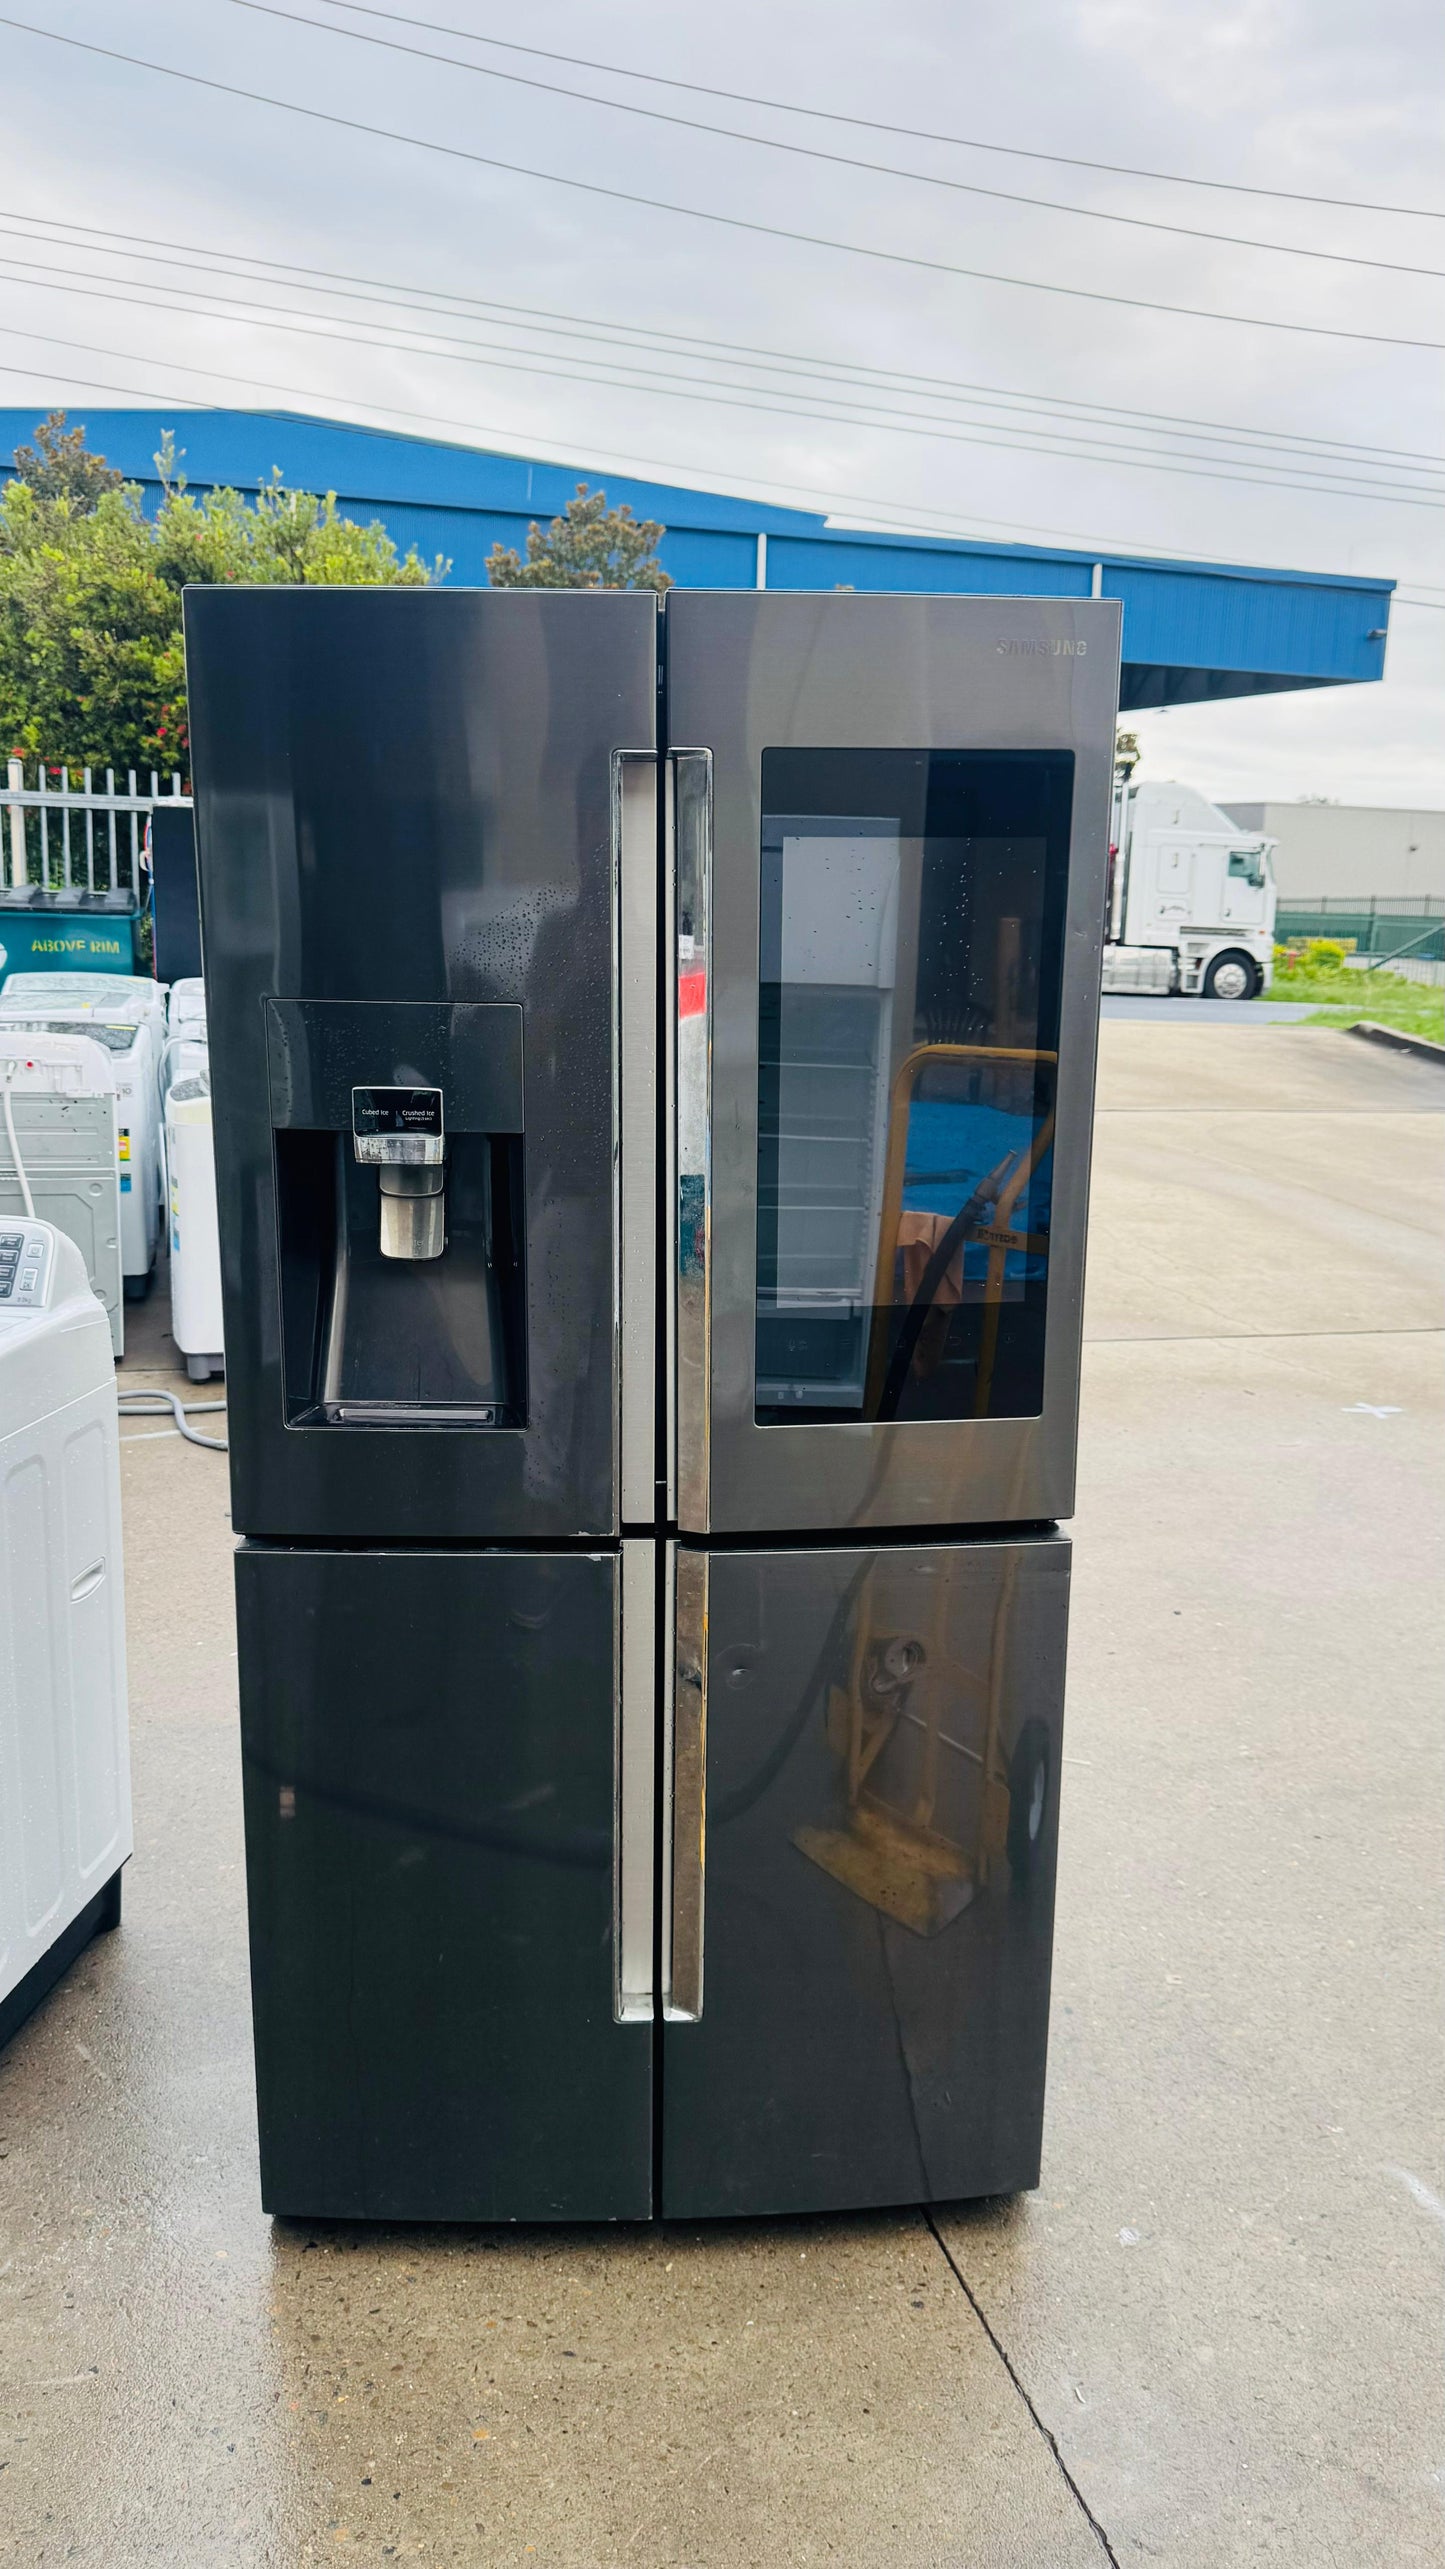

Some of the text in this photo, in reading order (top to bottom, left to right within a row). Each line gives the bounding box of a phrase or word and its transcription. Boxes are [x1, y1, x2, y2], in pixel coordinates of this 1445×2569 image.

[996, 638, 1088, 656] SAMSUNG
[31, 939, 120, 954] ABOVE RIM
[361, 1108, 379, 1116] Cubed
[402, 1109, 425, 1117] Crushed
